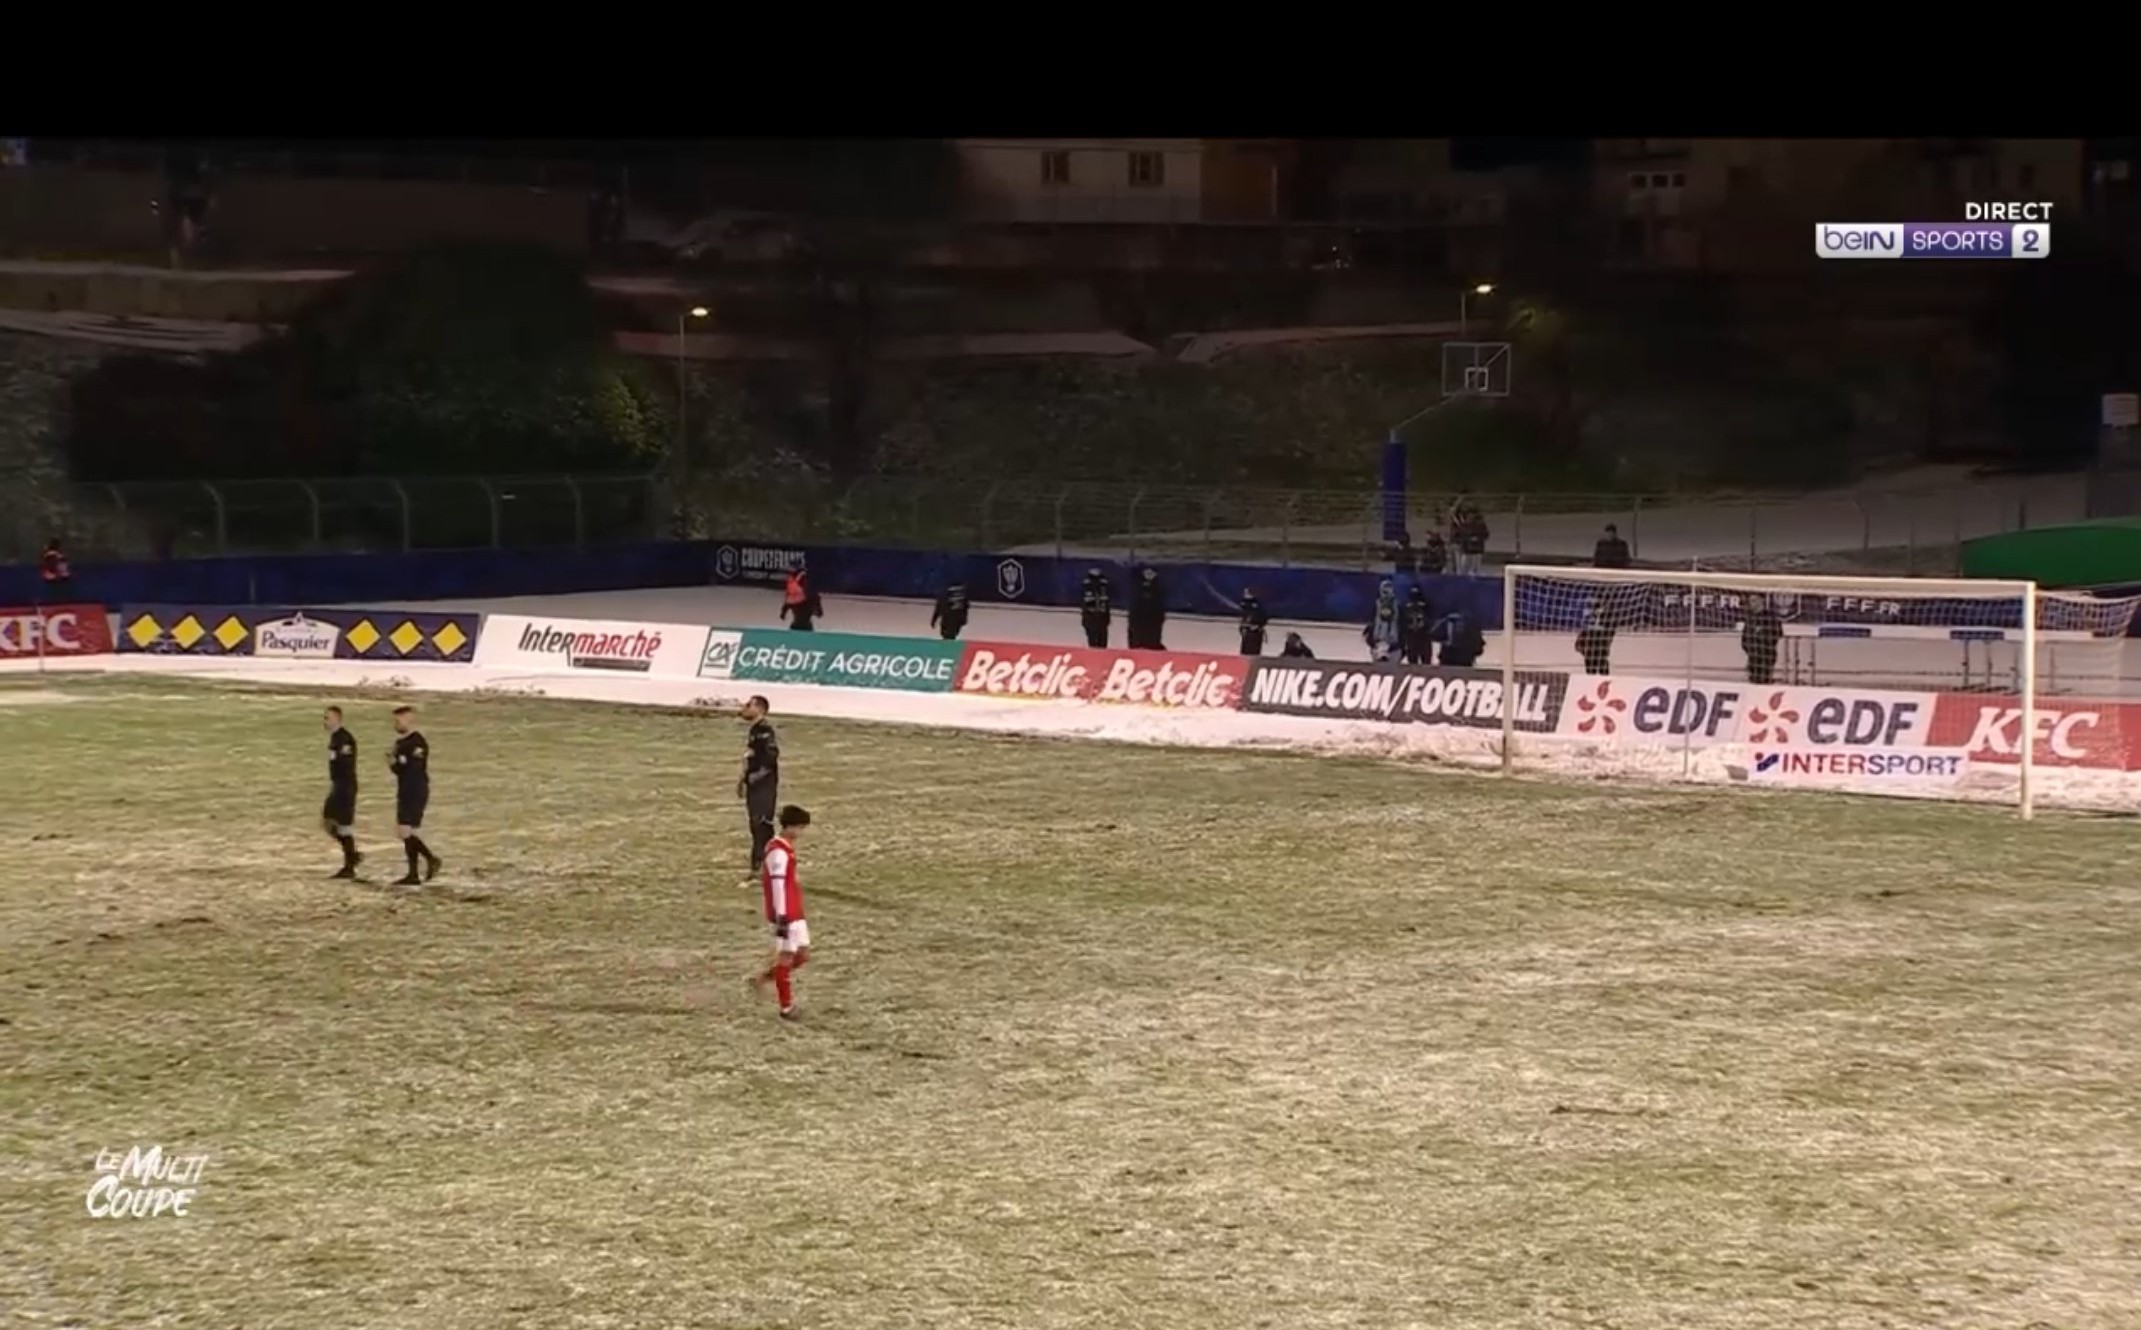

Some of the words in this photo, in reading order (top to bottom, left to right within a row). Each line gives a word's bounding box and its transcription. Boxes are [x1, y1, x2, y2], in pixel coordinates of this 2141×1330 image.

[262, 630, 330, 653] Pasquier
[518, 622, 662, 668] Intermarché
[739, 643, 827, 672] CRÉDIT
[827, 651, 954, 680] AGRICOLE
[963, 650, 1087, 696] Betclic
[1100, 658, 1233, 707] Betclic
[1968, 706, 2100, 759] KFC
[1782, 752, 1963, 776] INTERSPORT
